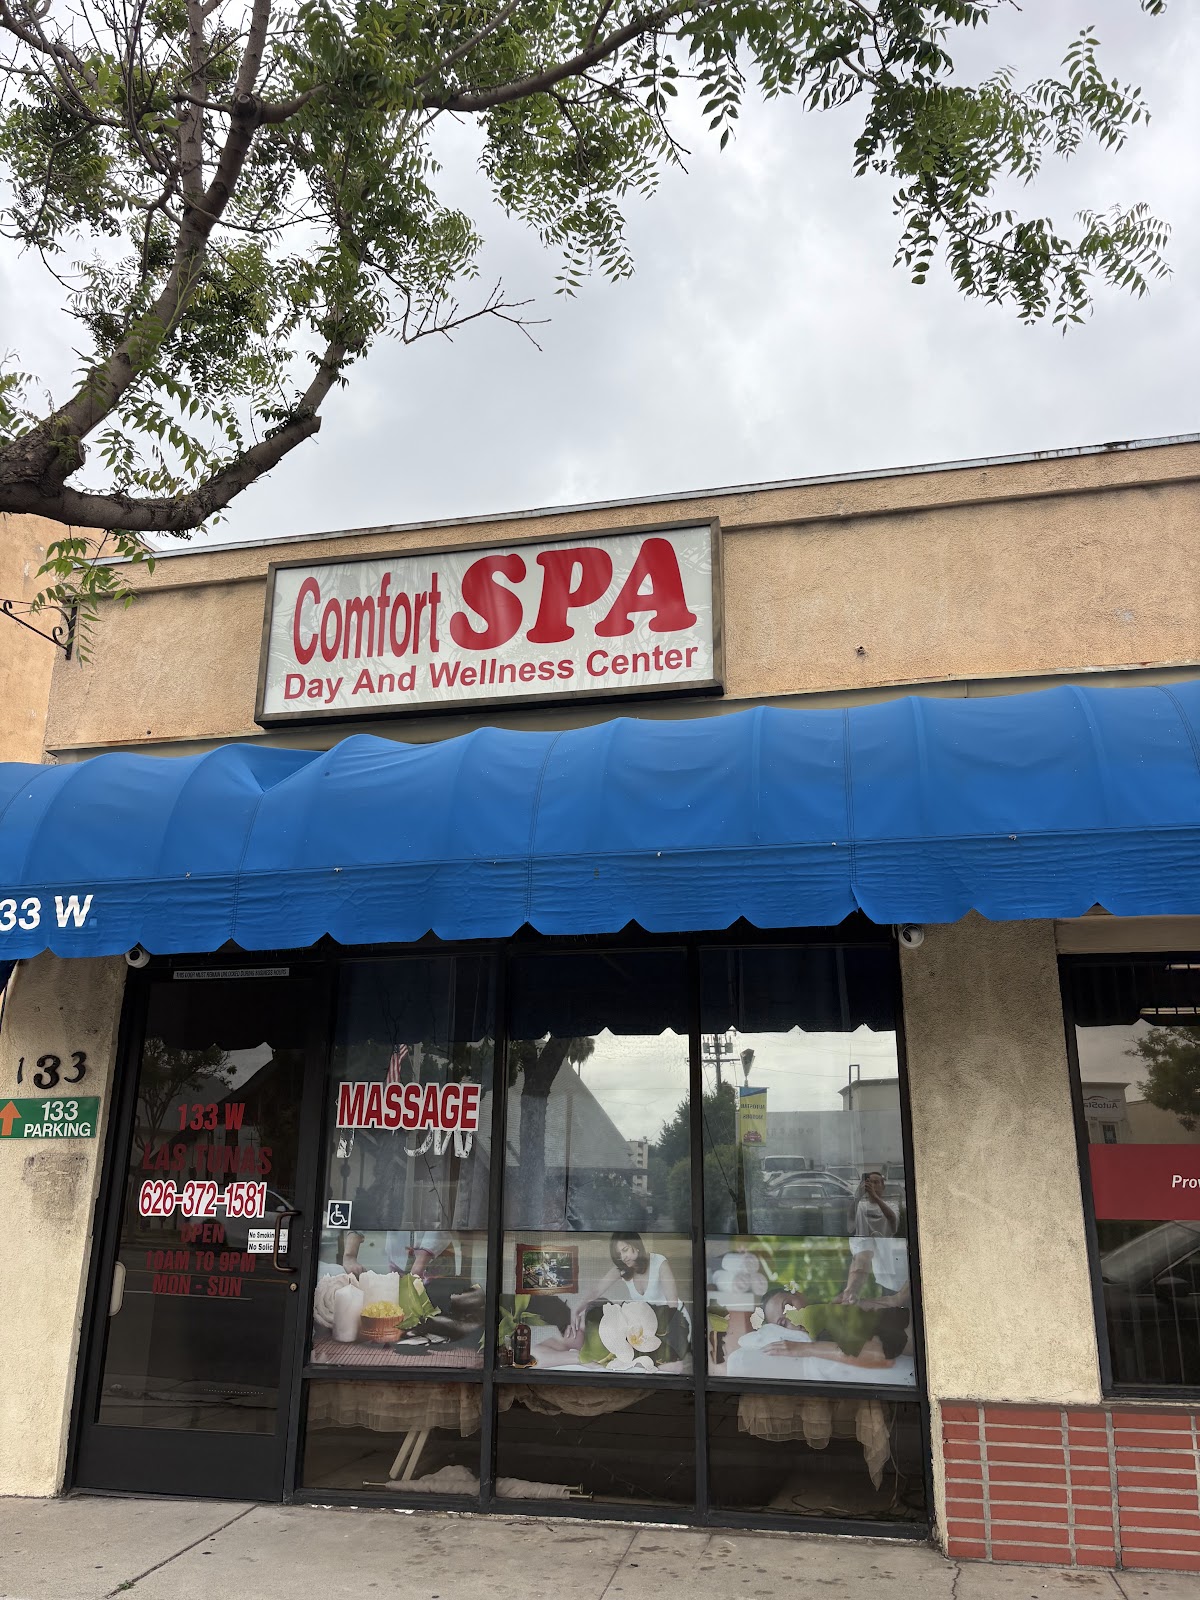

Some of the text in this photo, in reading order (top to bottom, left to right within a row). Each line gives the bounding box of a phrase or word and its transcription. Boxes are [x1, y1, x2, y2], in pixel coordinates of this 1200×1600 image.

[293, 537, 698, 666] Comfort SPA
[283, 645, 699, 704] Day And Wellness Center
[54, 895, 93, 928] W
[17, 1051, 87, 1089] 133
[41, 1101, 78, 1121] 133
[177, 1103, 246, 1131] 133 W
[337, 1083, 481, 1131] MASSAGE
[23, 1122, 91, 1137] PARKING
[142, 1143, 273, 1175] LAS TUNAS
[139, 1180, 267, 1217] 626-372-1581
[180, 1224, 225, 1243] OPEN
[248, 1243, 256, 1251] No
[257, 1231, 277, 1239] Smokin
[145, 1250, 256, 1273] 10AM TO 9PM
[152, 1274, 191, 1295] MON
[208, 1277, 242, 1296] SUN
